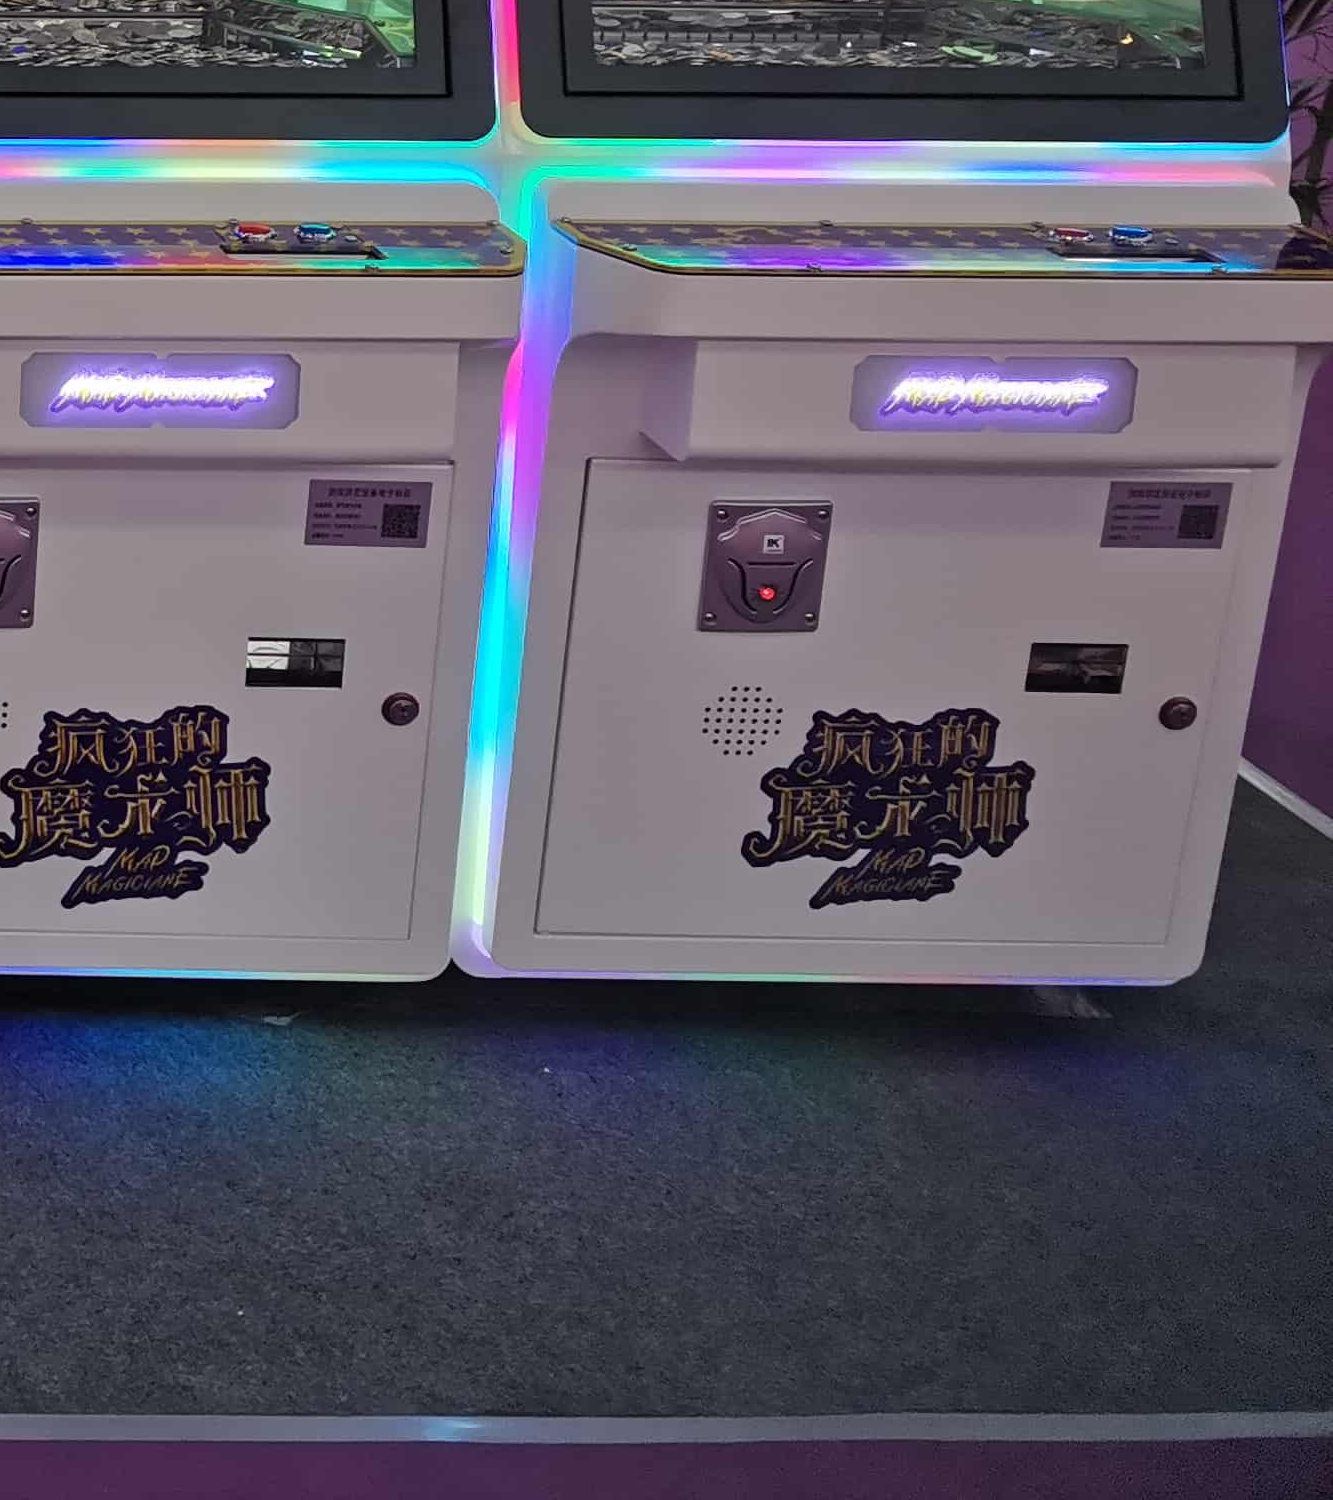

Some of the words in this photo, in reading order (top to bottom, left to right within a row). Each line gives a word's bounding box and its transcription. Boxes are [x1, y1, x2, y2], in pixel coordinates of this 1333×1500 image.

[37, 711, 226, 773] 疯狂的
[805, 713, 997, 775] 疯狂的
[744, 764, 1035, 858] 魔术师
